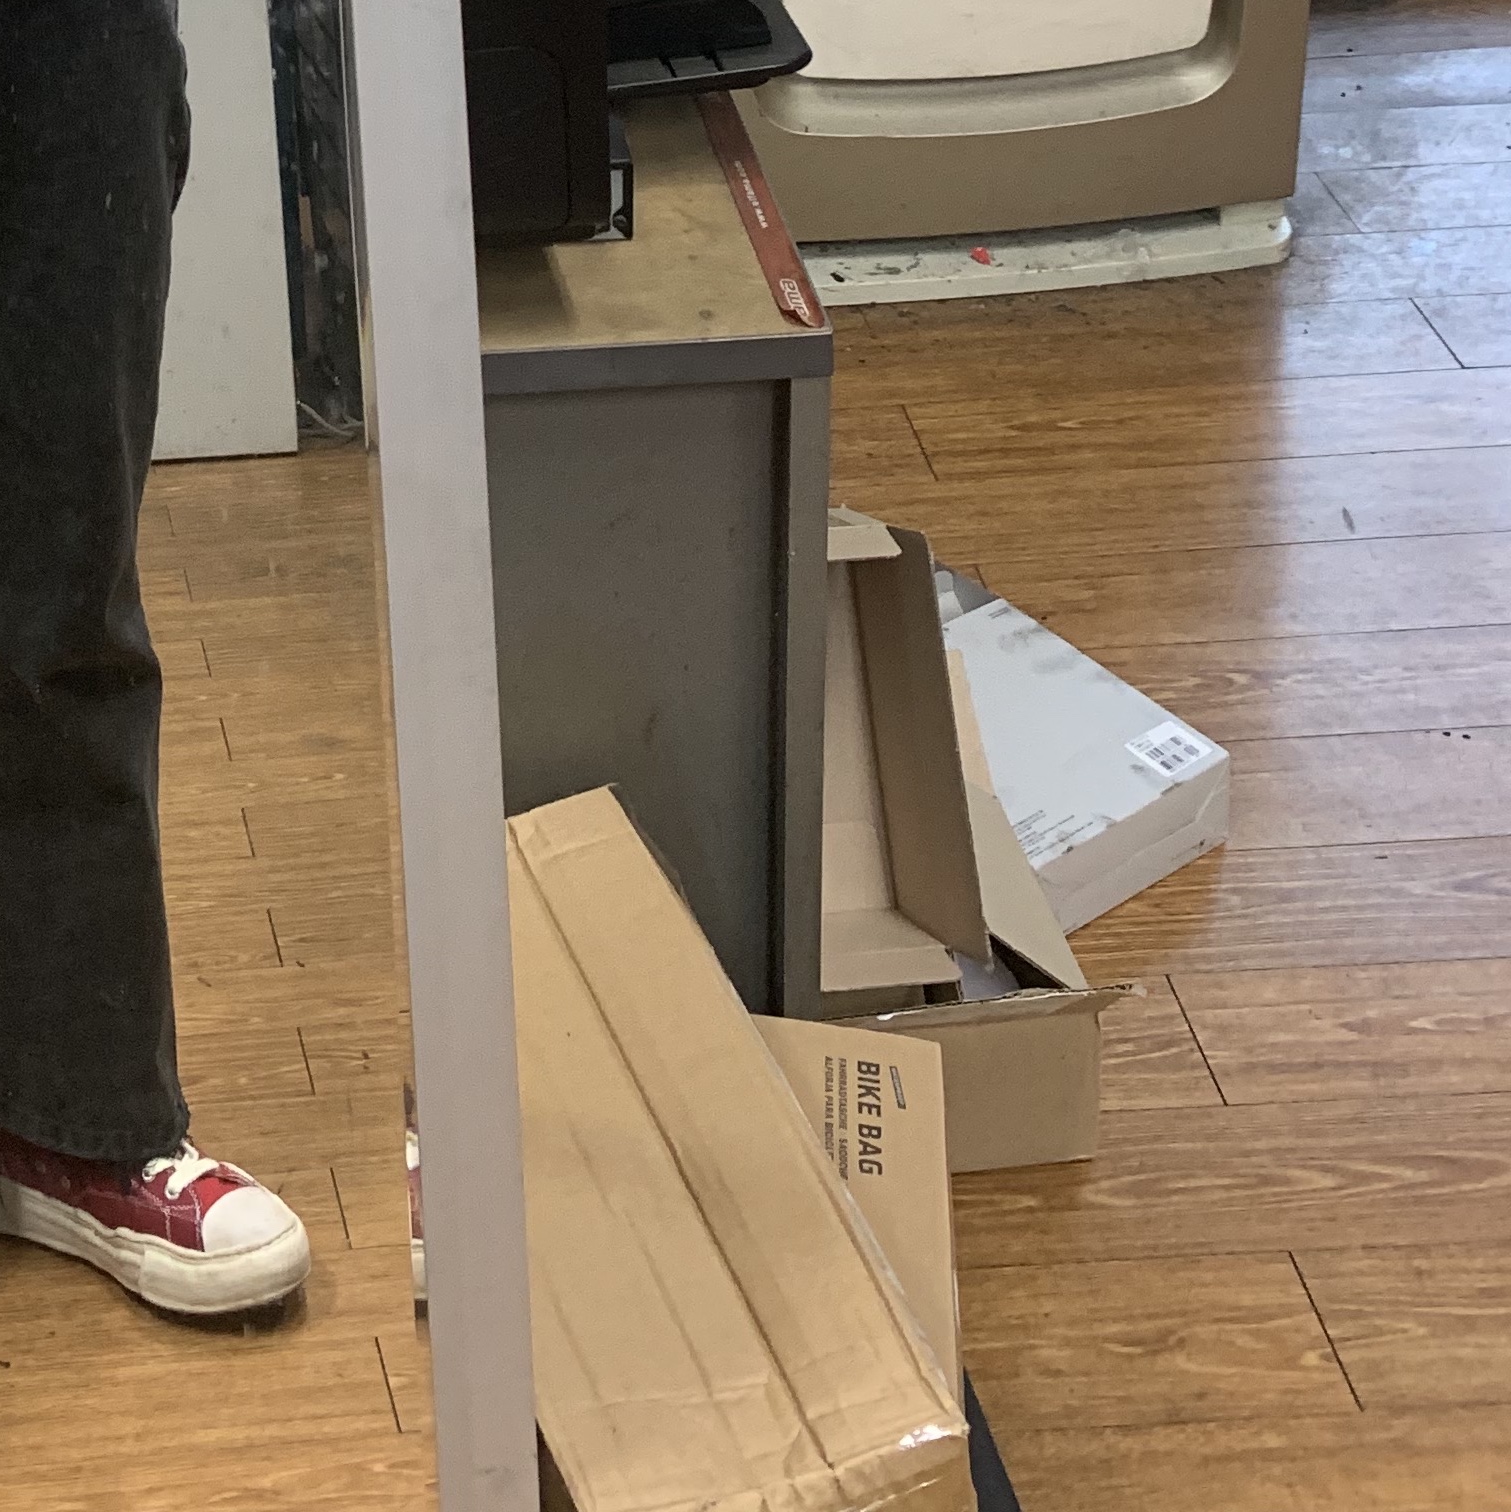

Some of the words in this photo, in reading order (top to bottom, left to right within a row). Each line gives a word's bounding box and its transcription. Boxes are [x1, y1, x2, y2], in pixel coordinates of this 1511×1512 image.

[824, 1095, 834, 1119] PARA
[857, 1060, 882, 1118] BIKE
[857, 1123, 883, 1176] BAG
